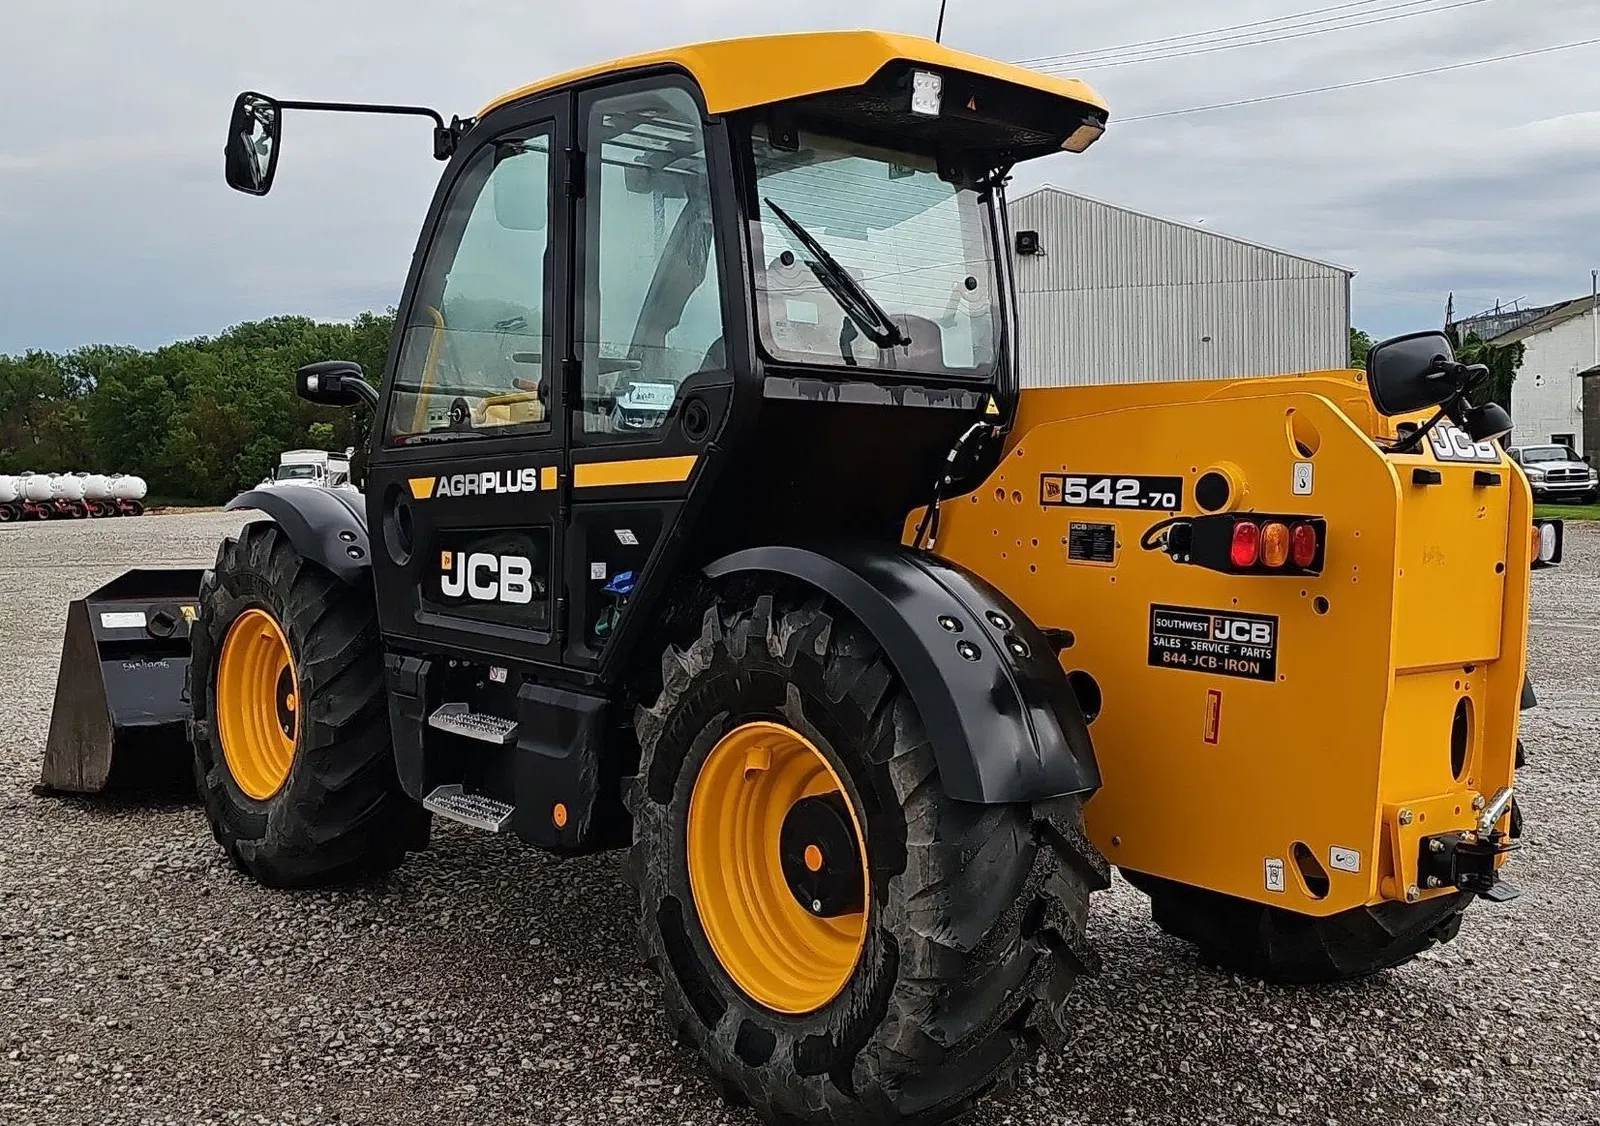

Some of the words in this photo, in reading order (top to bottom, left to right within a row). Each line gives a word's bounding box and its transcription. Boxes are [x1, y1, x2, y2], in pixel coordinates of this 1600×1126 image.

[436, 468, 537, 498] AGRIPLUS
[441, 552, 533, 604] JCB
[1155, 618, 1209, 632] SOUTHWEST
[1214, 620, 1271, 644] JCB
[1153, 636, 1181, 648] SALES
[1190, 640, 1230, 654] SERVICE
[1240, 647, 1272, 659] PARTS
[1162, 651, 1260, 674] 844-JCB-IRON
